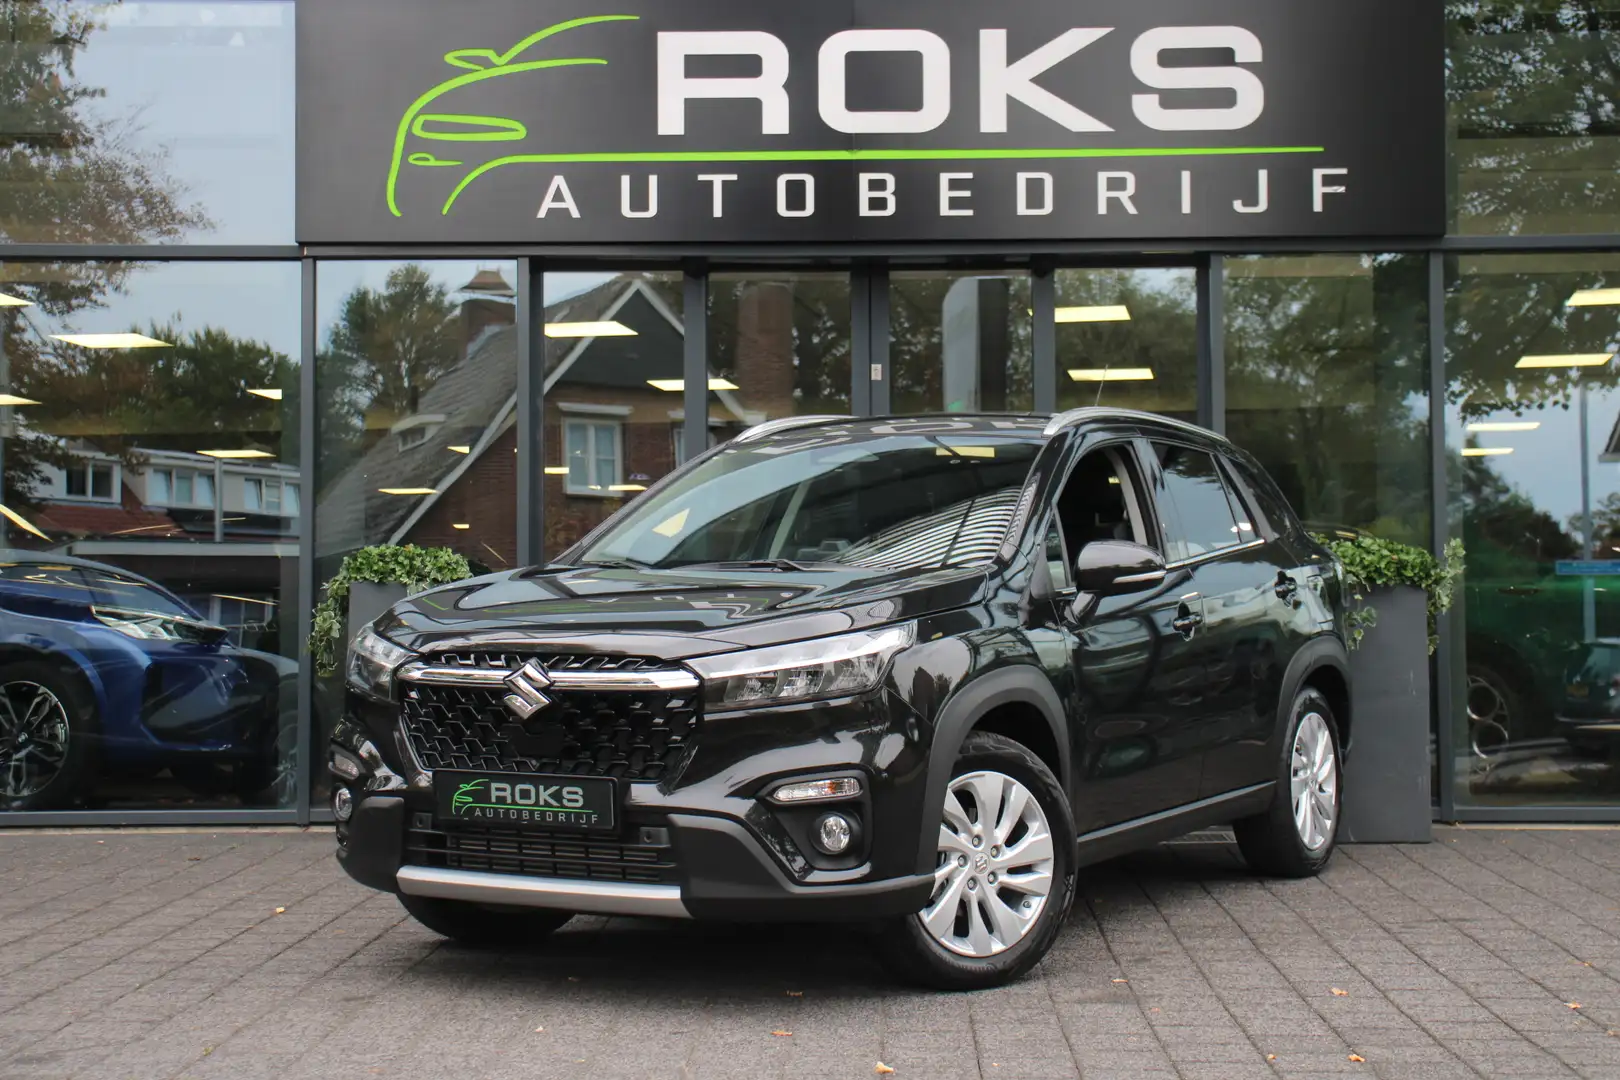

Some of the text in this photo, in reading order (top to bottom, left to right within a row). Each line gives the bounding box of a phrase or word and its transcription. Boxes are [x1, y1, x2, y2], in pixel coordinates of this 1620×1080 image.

[657, 25, 1265, 136] ROKS
[536, 168, 1348, 219] AUTOBEDRIJF
[490, 782, 584, 807] ROKS
[474, 807, 598, 824] AUTOBEDRIJF
